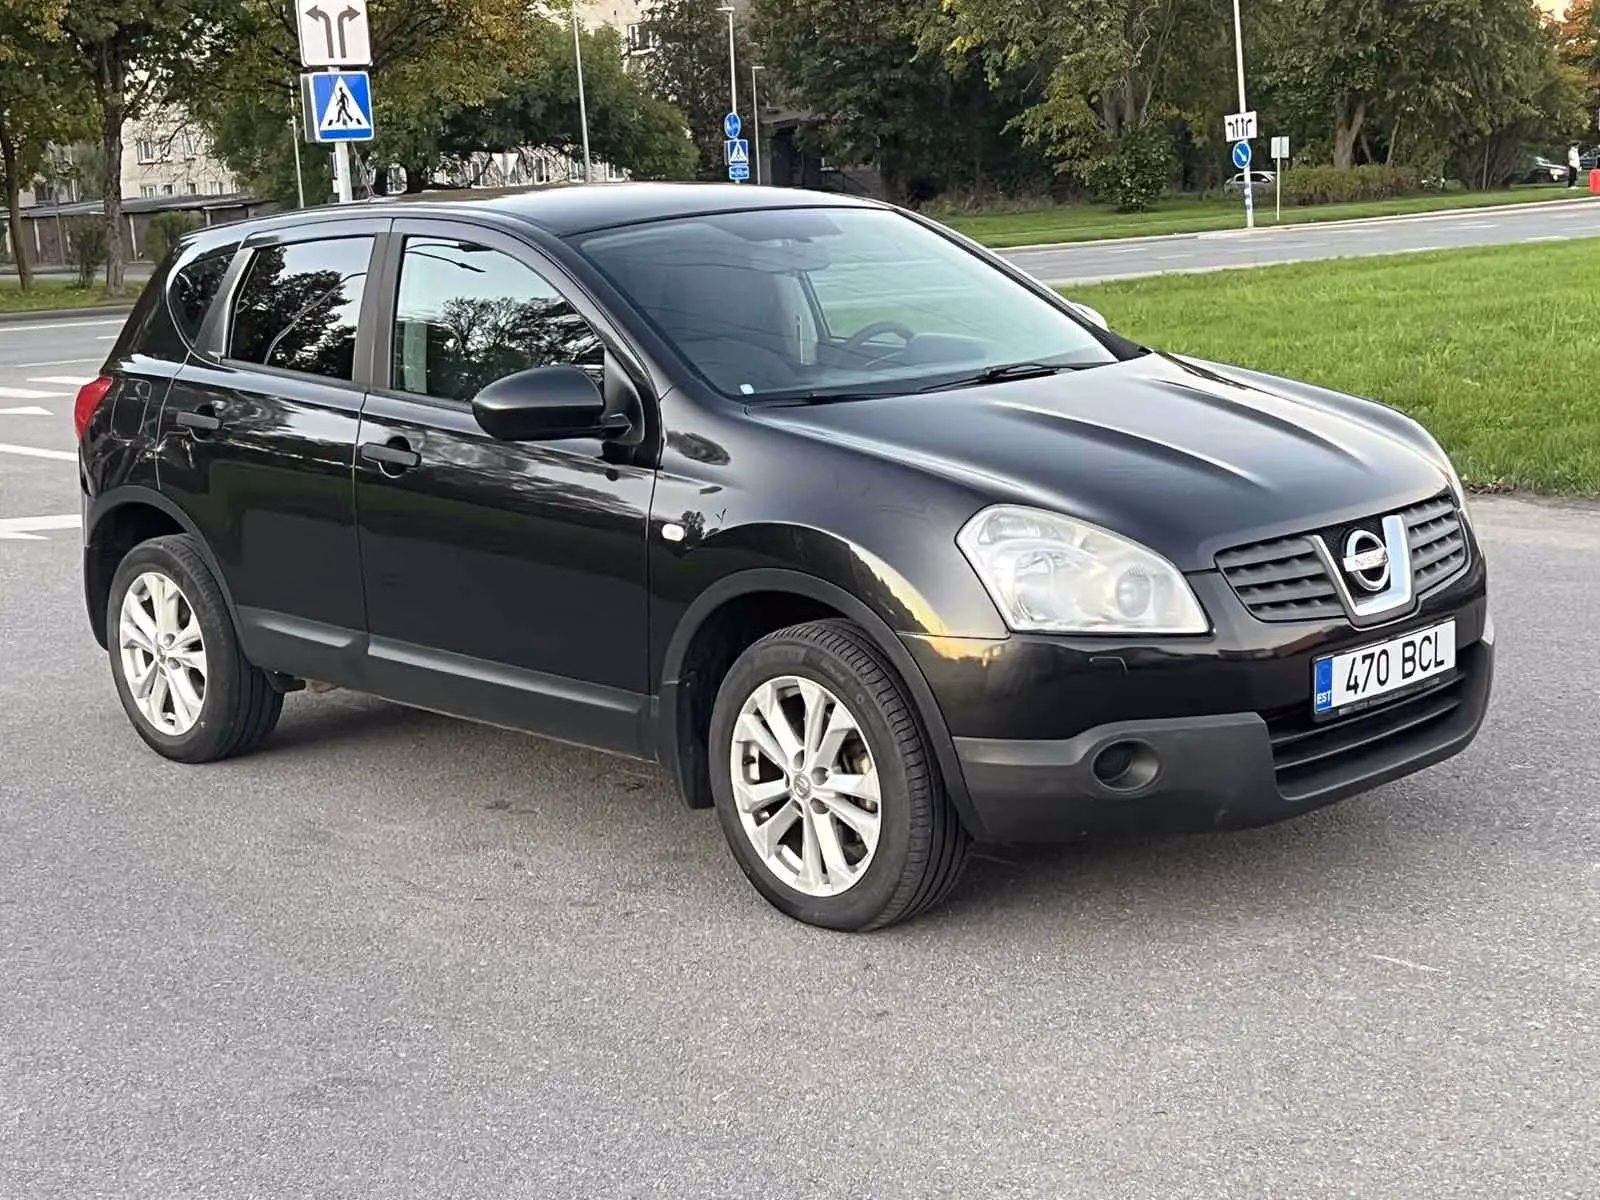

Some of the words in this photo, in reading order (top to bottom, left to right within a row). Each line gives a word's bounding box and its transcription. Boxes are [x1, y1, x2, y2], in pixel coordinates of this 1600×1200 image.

[1346, 649, 1390, 695] 470
[1401, 631, 1446, 680] BCL
[1316, 690, 1331, 705] EST
